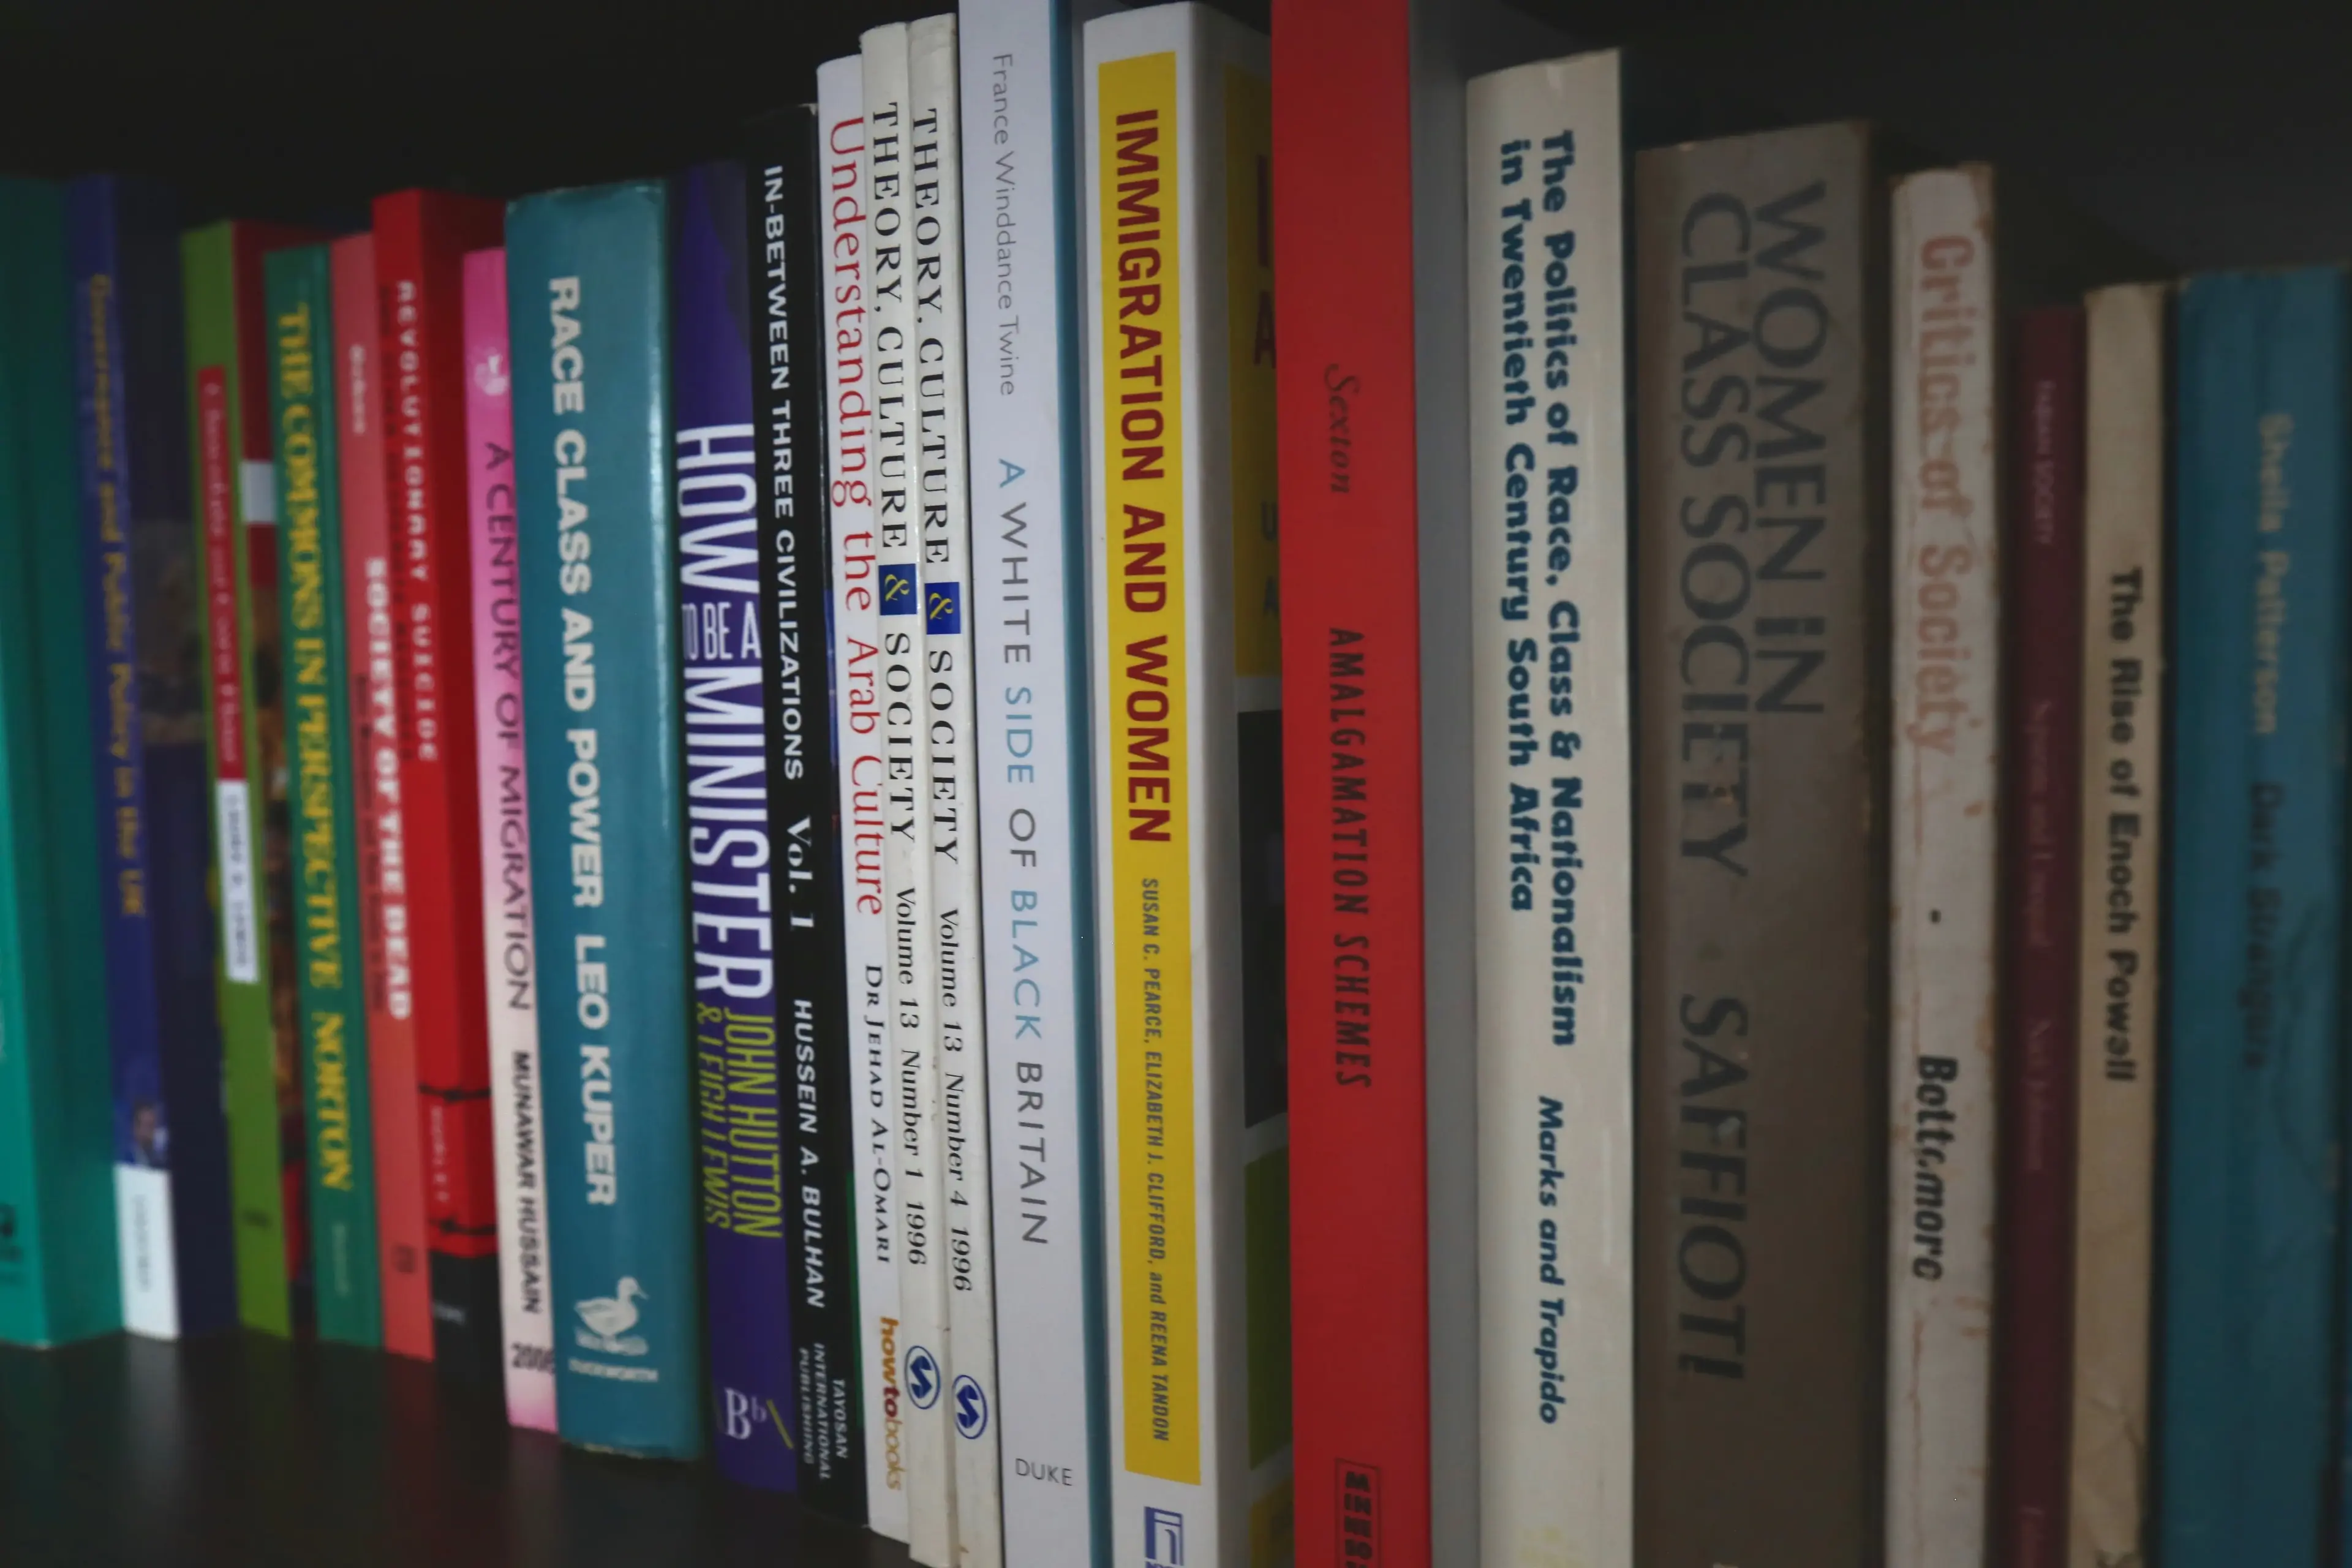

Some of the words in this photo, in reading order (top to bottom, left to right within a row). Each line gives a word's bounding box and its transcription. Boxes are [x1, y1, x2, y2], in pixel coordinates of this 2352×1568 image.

[991, 53, 1014, 145] France
[870, 101, 903, 313] THEORY,
[911, 107, 942, 323] THEORY,
[1499, 140, 1531, 184] in
[1542, 130, 1574, 212] The
[763, 165, 790, 390] IN-BETWEEN
[992, 151, 1019, 311] Winddance
[278, 303, 313, 396] THE
[548, 277, 584, 415] RACE
[829, 117, 873, 508] Understanding
[1115, 109, 1165, 482] IMMIGRATION
[1501, 198, 1536, 425] Twentieth
[1542, 231, 1577, 389] Politics
[1679, 192, 1751, 469] CLASS
[1918, 235, 1975, 435] Critics
[996, 315, 1020, 396] Twine
[1753, 179, 1829, 581] WOMEN
[395, 280, 428, 582] REVOLUTIONARY
[484, 443, 509, 470] A
[770, 400, 793, 518] THREE
[876, 325, 908, 549] CULTURE
[917, 337, 949, 565] CULTURE
[997, 458, 1027, 489] A
[1322, 362, 1363, 495] Sexton
[1545, 402, 1578, 447] of
[280, 404, 325, 628] COMMONS
[556, 429, 591, 595] CLASS
[675, 423, 759, 594] HOW
[1500, 442, 1536, 620] Century
[1544, 466, 1578, 587] Race,
[1918, 457, 1975, 516] of
[487, 483, 521, 676] CENTURY
[842, 532, 876, 612] the
[883, 575, 910, 605] &
[926, 593, 952, 622] &
[1000, 502, 1030, 665] WHITE
[1122, 503, 1166, 614] AND
[2109, 567, 2143, 641] The
[292, 639, 326, 684] IN
[364, 557, 398, 739] SOCIETY
[410, 603, 437, 762] SUICIDE
[560, 608, 596, 711] AND
[702, 601, 733, 661] BE
[740, 600, 763, 659] A
[775, 529, 803, 780] CIVILIZATIONS
[846, 637, 882, 735] Arab
[1547, 599, 1580, 717] Class
[1679, 495, 1751, 876] SOCIETY
[1905, 544, 1974, 755] Society
[495, 693, 522, 748] OF
[884, 632, 916, 844] SOCIETY
[1005, 686, 1033, 785] SIDE
[1125, 634, 1171, 844] WOMEN
[1506, 638, 1539, 767] South
[1549, 729, 1581, 760] &
[2109, 658, 2143, 744] Rise
[374, 747, 399, 804] OF
[927, 649, 959, 867] SOCIETY
[1327, 628, 1369, 915] AMALGAMATION
[2108, 758, 2143, 798] of
[295, 695, 342, 990] PERSPECTIVE
[377, 811, 404, 895] THE
[565, 728, 604, 907] POWER
[683, 666, 774, 999] MINISTER
[785, 815, 813, 894] Vol.
[850, 755, 885, 917] Culture
[1008, 808, 1036, 869] OF
[1508, 782, 1540, 911] Africa
[2106, 813, 2141, 933] Enoch
[499, 766, 530, 1011] MIGRATION
[788, 911, 814, 932] 1
[896, 888, 919, 984] Volume
[1140, 878, 1161, 937] SUSAN
[1550, 776, 1583, 1046] Nationalism
[383, 905, 412, 1020] DEAD
[573, 935, 609, 1029] LEO
[938, 909, 960, 1007] Volume
[1010, 889, 1042, 1039] BLACK
[1141, 967, 1163, 1044] PEARCE,
[1142, 943, 1161, 961] C.
[696, 1001, 722, 1024] &
[723, 1007, 777, 1095] JOHN
[793, 999, 818, 1133] HUSSEIN
[899, 998, 921, 1029] 13
[942, 1022, 963, 1052] 13
[1332, 933, 1372, 1089] SCHEMES
[311, 1012, 353, 1191] NORTON
[511, 1052, 535, 1189] MUNAWAR
[579, 1044, 616, 1205] KUPER
[697, 1035, 728, 1123] LEIGH
[899, 1049, 923, 1156] Number
[944, 1072, 966, 1182] Number
[1144, 1050, 1164, 1148] ELIZABETH
[699, 1128, 731, 1230] LEWIS
[728, 1104, 783, 1238] HUTTON
[799, 1146, 820, 1177] A.
[904, 1168, 924, 1179] 1
[948, 1190, 969, 1207] 4
[1015, 1062, 1049, 1245] BRITAIN
[1145, 1152, 1165, 1166] J.
[1537, 1096, 1564, 1207] Marks
[1676, 995, 1750, 1380] SAFFIOTI
[517, 1197, 540, 1314] HUSSAIN
[801, 1185, 826, 1309] BULHAN
[905, 1200, 928, 1266] 1996
[949, 1227, 972, 1292] 1996
[1145, 1172, 1166, 1266] CLIFFORD,
[1538, 1219, 1564, 1285] and
[1147, 1272, 1168, 1305] and
[1148, 1310, 1169, 1366] REENA
[813, 1343, 831, 1481] INTERNATIONAL
[1150, 1373, 1170, 1442] TANDON
[1533, 1298, 1565, 1424] Trapido
[831, 1379, 848, 1459] TAYOSAN
[1014, 1458, 1072, 1487] DUKE
